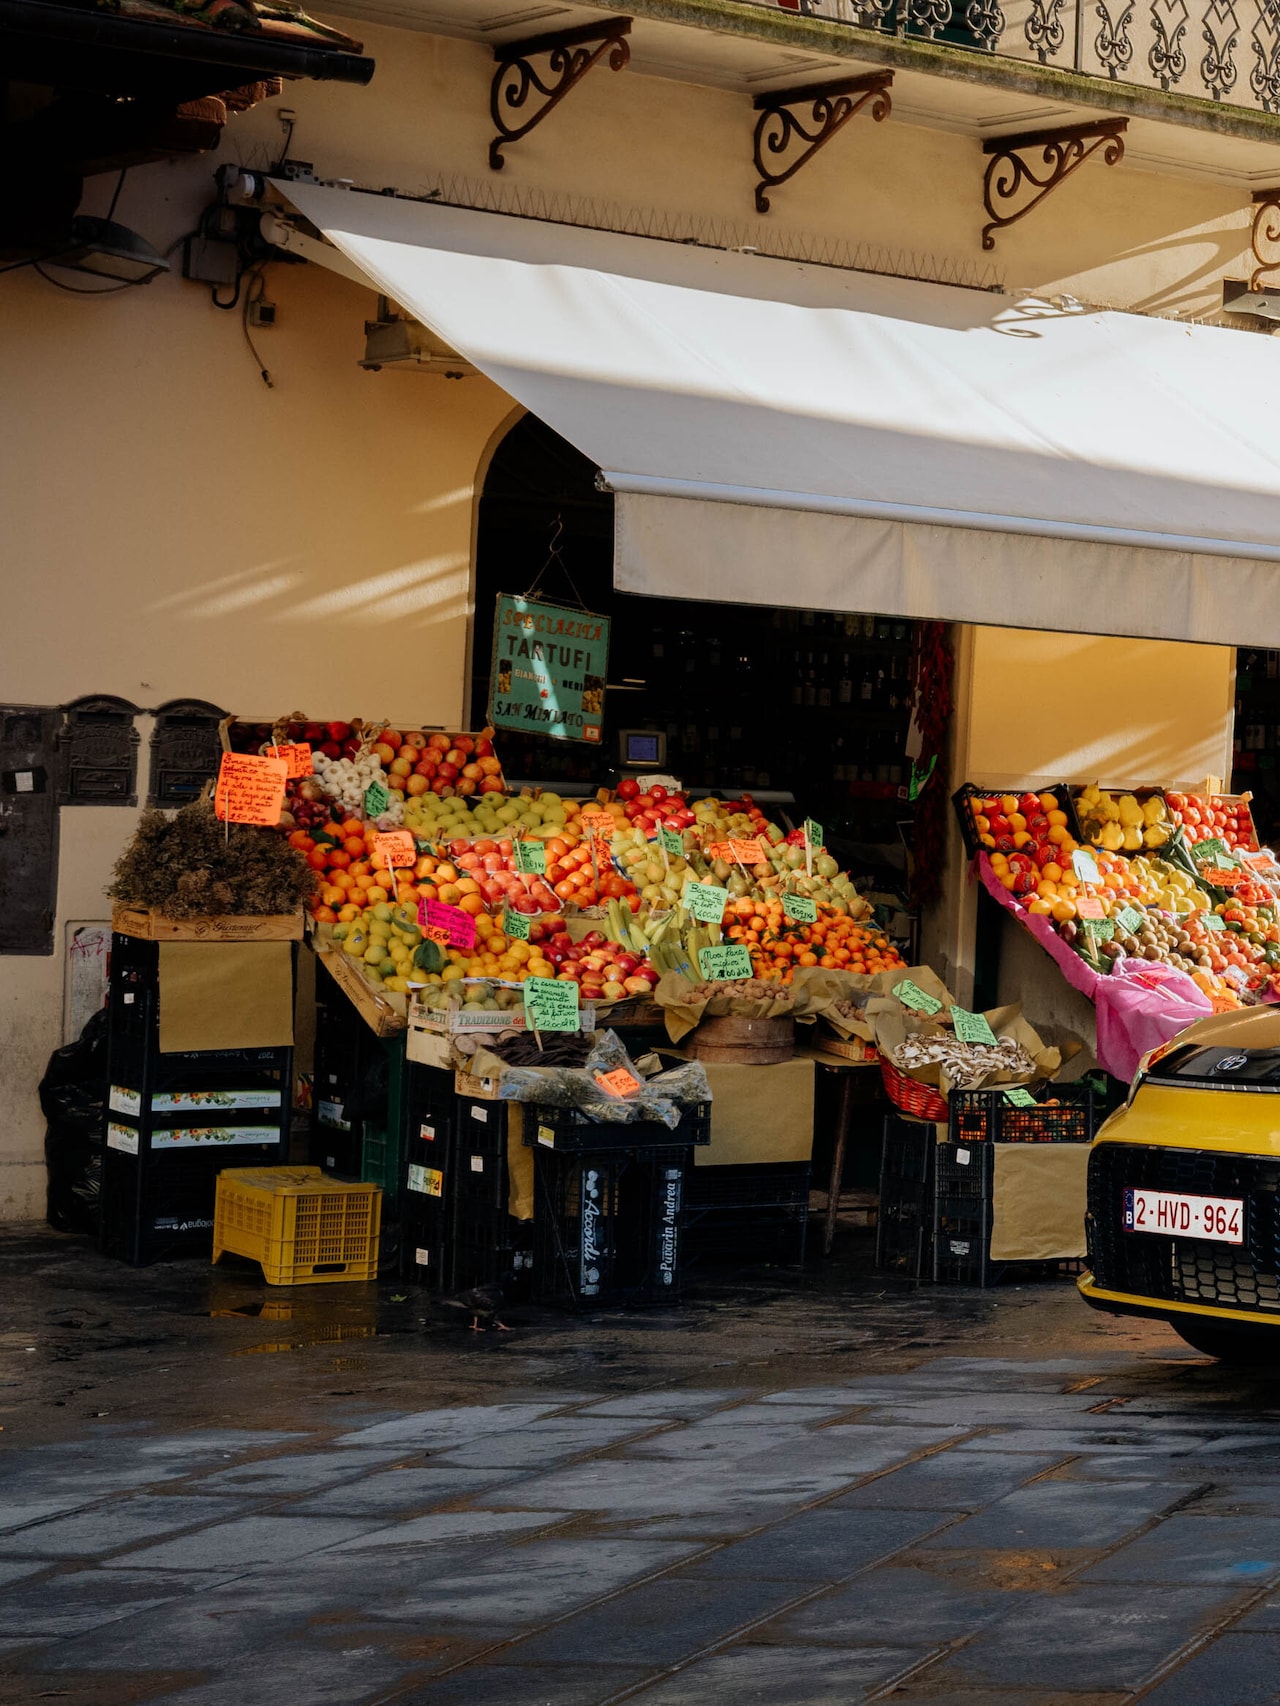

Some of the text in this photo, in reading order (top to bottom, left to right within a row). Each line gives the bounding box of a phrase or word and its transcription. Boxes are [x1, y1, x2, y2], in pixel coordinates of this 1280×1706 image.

[506, 634, 592, 672] TARTUFI
[495, 700, 584, 728] SAN MINIATO
[458, 1014, 511, 1025] TRADIZIONE
[584, 1199, 601, 1261] Accordi
[660, 1182, 676, 1272] Pavarin Andrea
[1125, 1211, 1133, 1225] B
